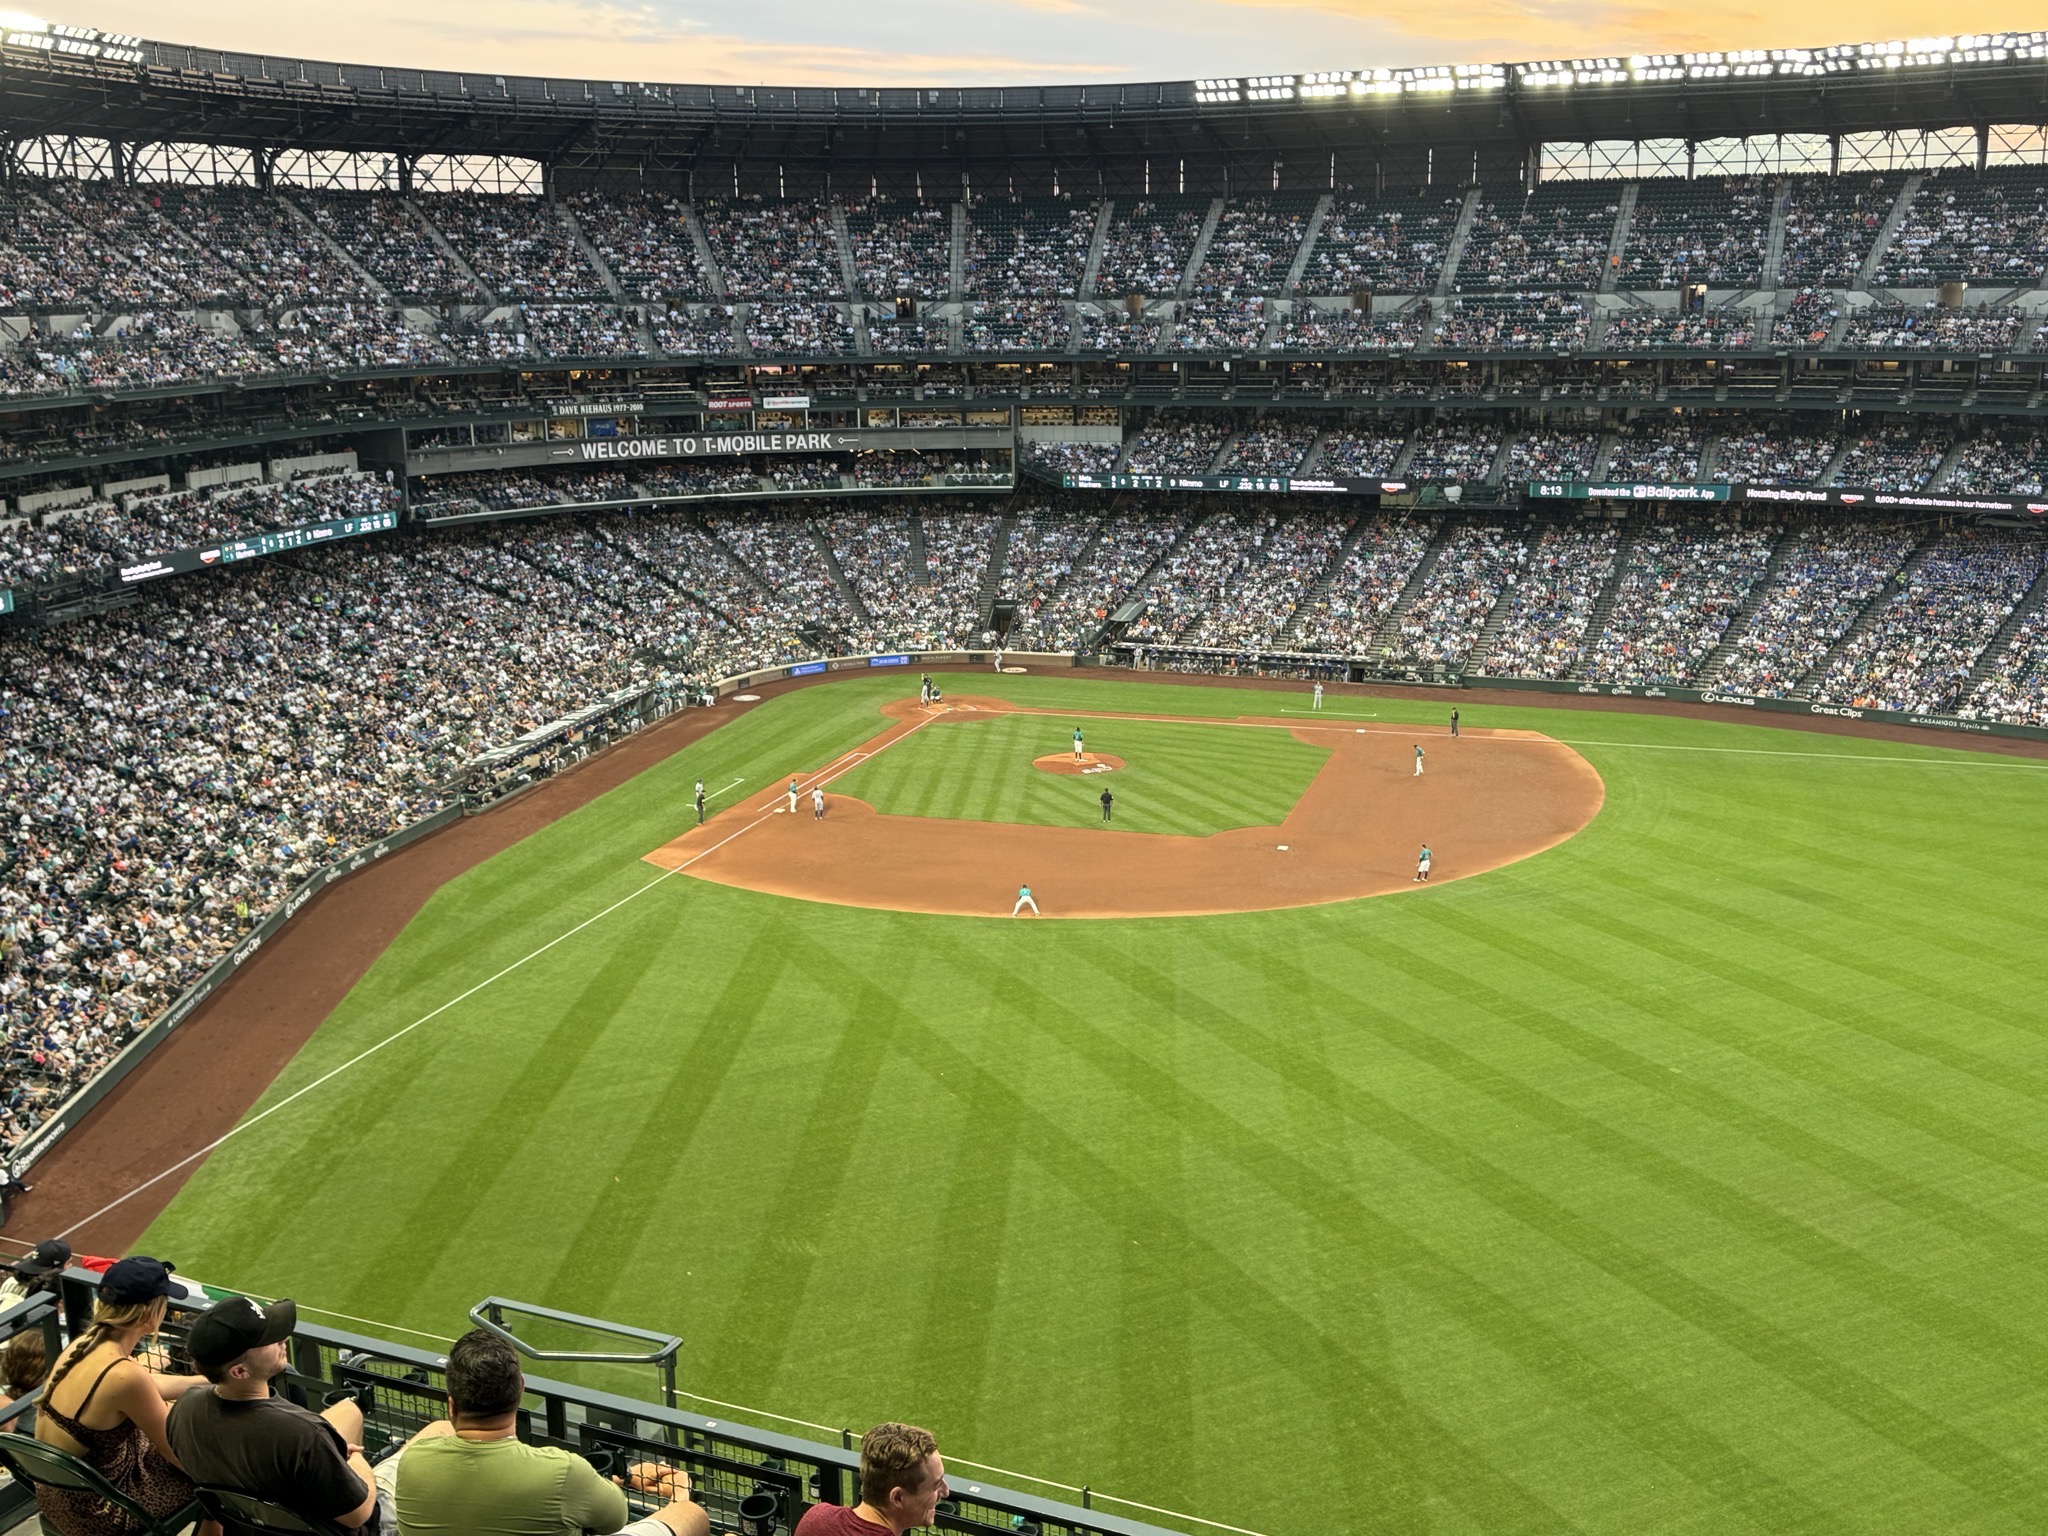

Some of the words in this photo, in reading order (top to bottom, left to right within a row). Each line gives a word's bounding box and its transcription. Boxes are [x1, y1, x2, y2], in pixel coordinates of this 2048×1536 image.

[560, 405, 579, 415] DAVE
[580, 404, 612, 414] NIEHAUS
[613, 403, 644, 412] 1977-2010
[581, 439, 668, 459] WELCOME
[672, 438, 697, 454] TO
[702, 435, 782, 453] T-MOBILE
[786, 433, 832, 450] PARK
[1155, 480, 1162, 488] 2
[1170, 479, 1176, 487] 9
[1179, 479, 1203, 487] Nimmo
[1219, 480, 1230, 488] LF
[1540, 485, 1562, 495] 8:13
[1588, 487, 1619, 496] Download
[1619, 488, 1631, 496] the
[1701, 489, 1715, 499] App
[1747, 489, 1780, 499] Housing
[1780, 489, 1806, 501] Equity
[1806, 491, 1827, 501] Fund
[1899, 496, 1932, 505] affordable
[1933, 498, 1955, 507] homes
[1956, 499, 1963, 507] in
[1975, 501, 2012, 510] hometown
[1578, 685, 1599, 693] Corona
[1611, 687, 1632, 695] Corona
[1645, 689, 1666, 697] Corona
[1715, 695, 1755, 705] LEXUS
[1810, 704, 1839, 715] Great
[1839, 707, 1863, 718] Clips
[1919, 717, 1958, 727] CASAMIGOS
